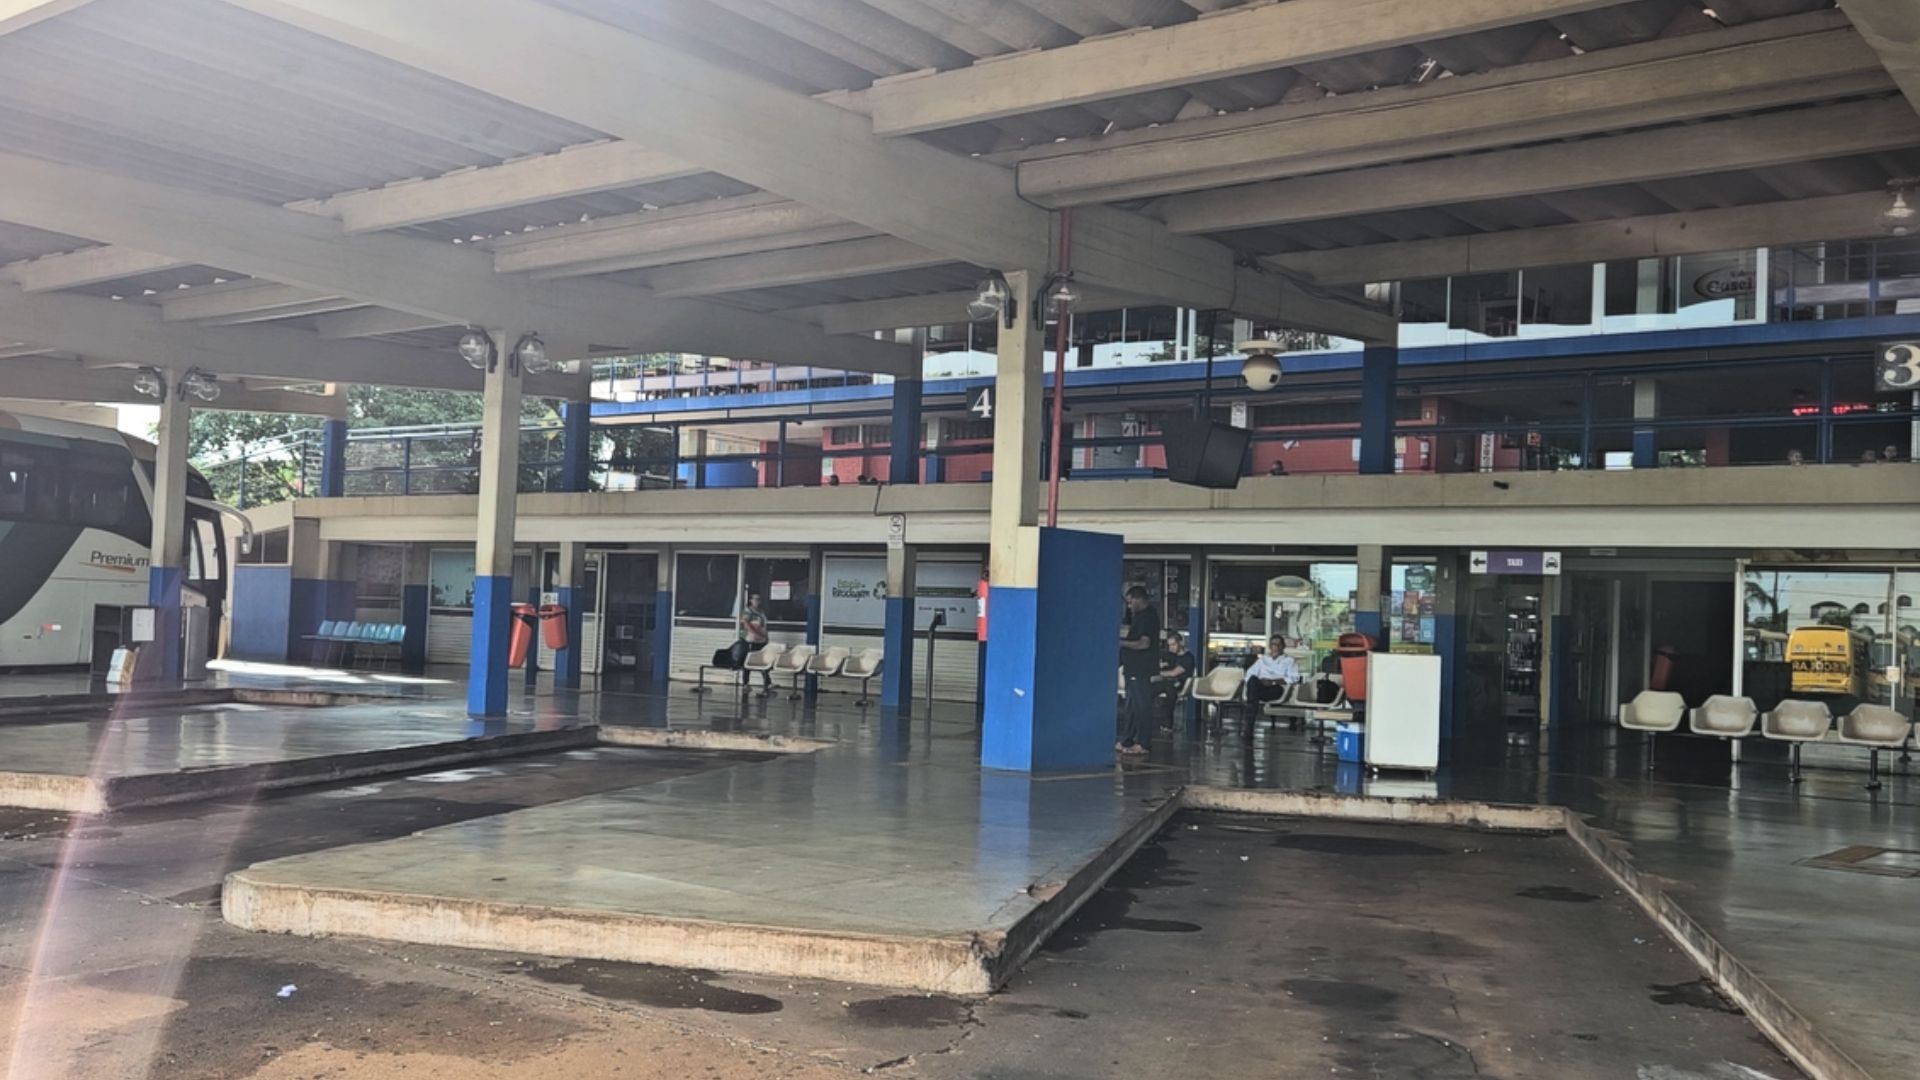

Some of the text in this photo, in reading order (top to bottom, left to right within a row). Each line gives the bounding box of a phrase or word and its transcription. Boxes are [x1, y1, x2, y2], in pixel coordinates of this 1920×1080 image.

[1884, 344, 1920, 386] 3
[972, 388, 991, 418] 4
[91, 551, 150, 566] Premium
[1507, 558, 1523, 566] TAXI
